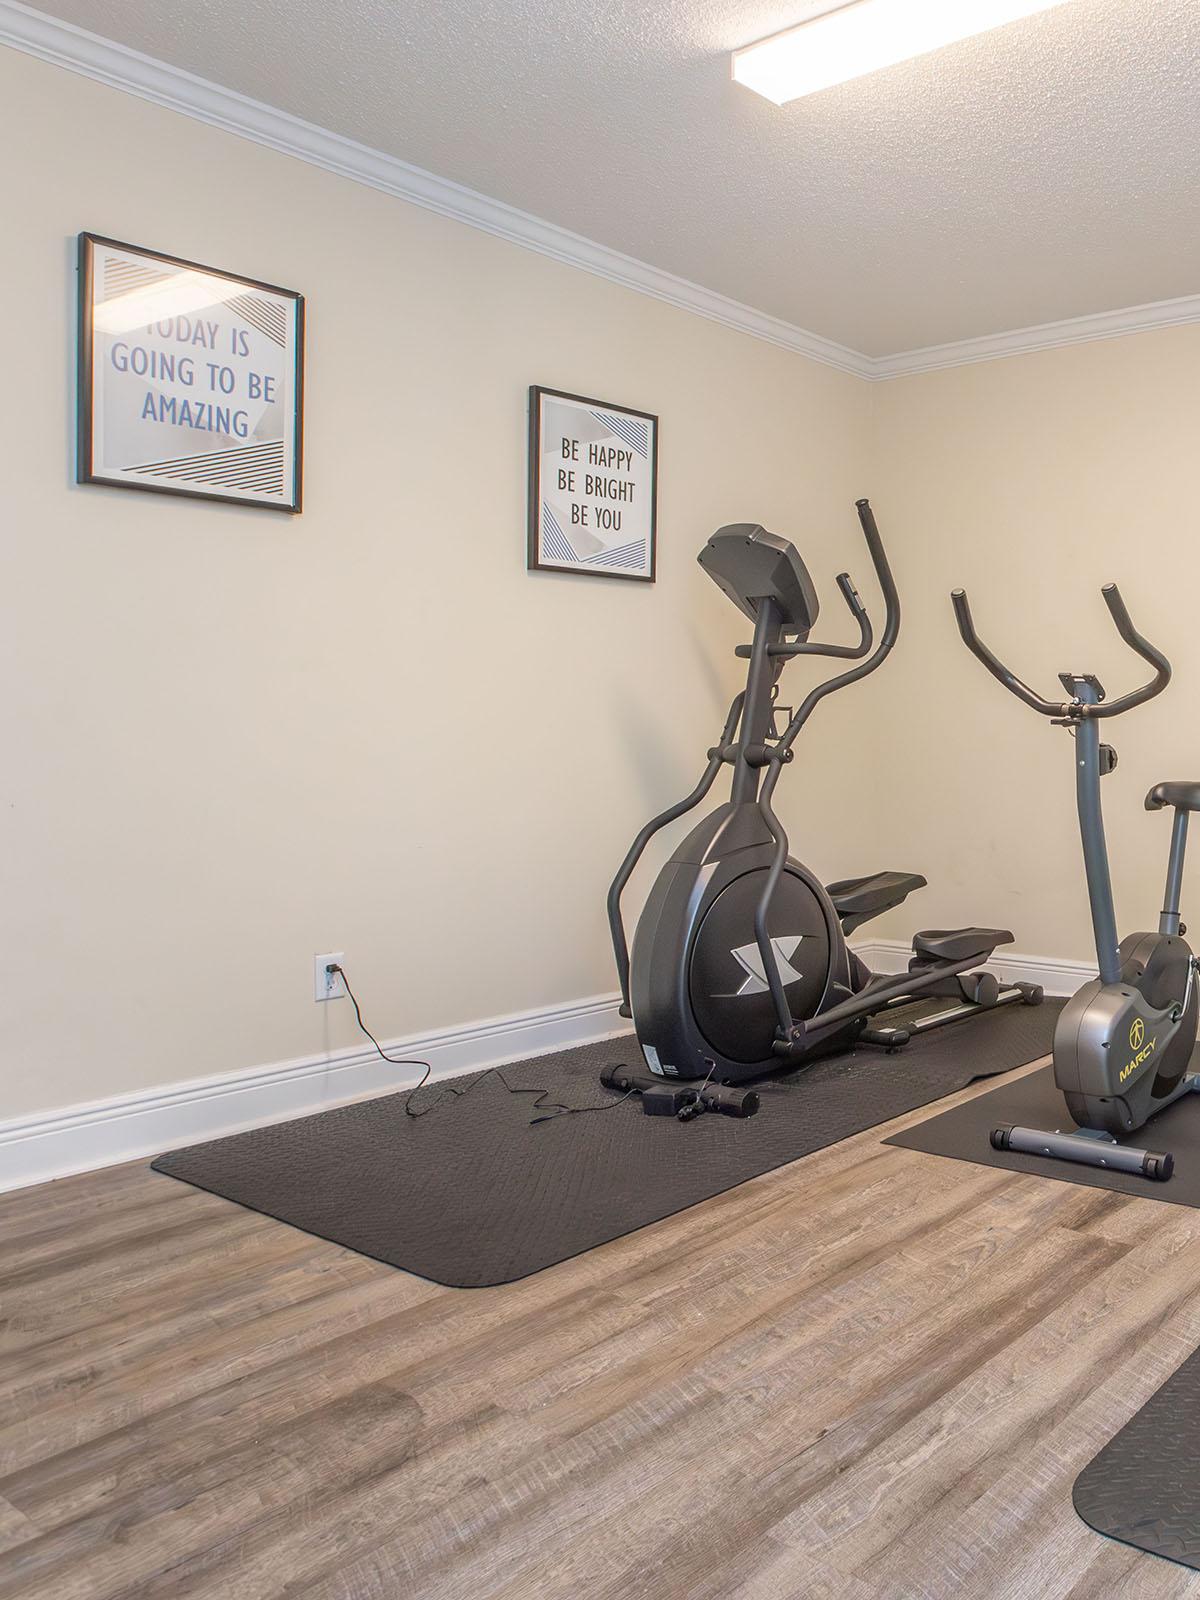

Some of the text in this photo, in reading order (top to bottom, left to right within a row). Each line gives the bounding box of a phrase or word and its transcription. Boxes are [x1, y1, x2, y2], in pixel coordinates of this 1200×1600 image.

[231, 328, 249, 357] IS
[111, 342, 275, 403] GOING TO BE
[141, 391, 249, 437] AMAZING
[562, 437, 632, 472] BE HAPPY
[558, 469, 635, 502] BE BRIGHT
[571, 503, 622, 531] BE YOU
[1119, 1037, 1157, 1083] MARCY
